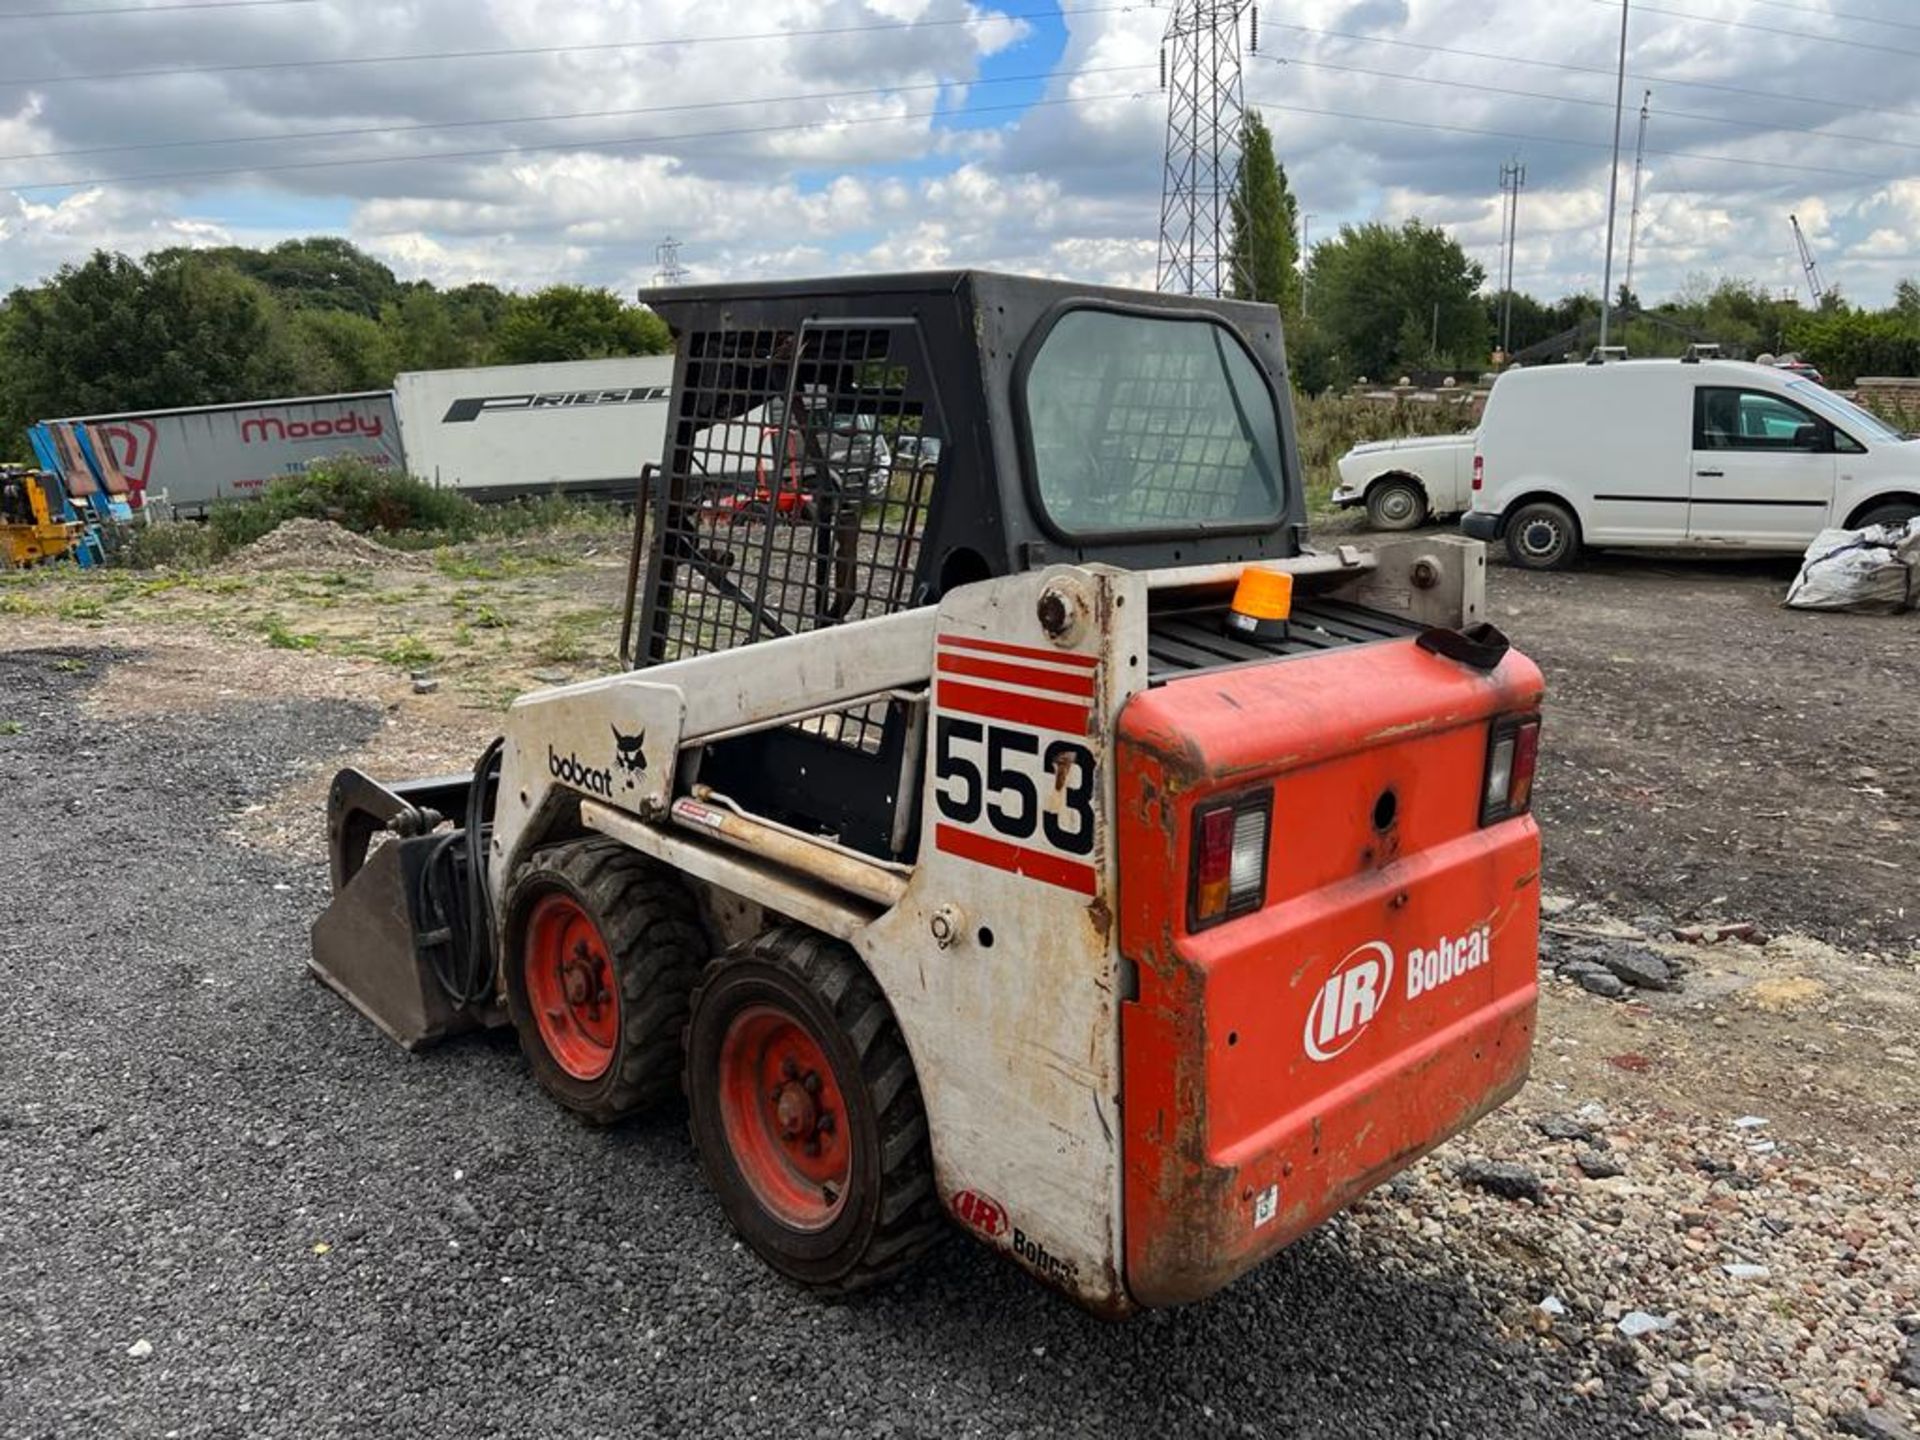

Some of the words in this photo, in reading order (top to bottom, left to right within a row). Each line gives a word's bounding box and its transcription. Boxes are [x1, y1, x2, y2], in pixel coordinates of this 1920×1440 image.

[549, 744, 613, 798] bobcat
[936, 715, 1096, 855] 553
[1319, 960, 1379, 1046] IR
